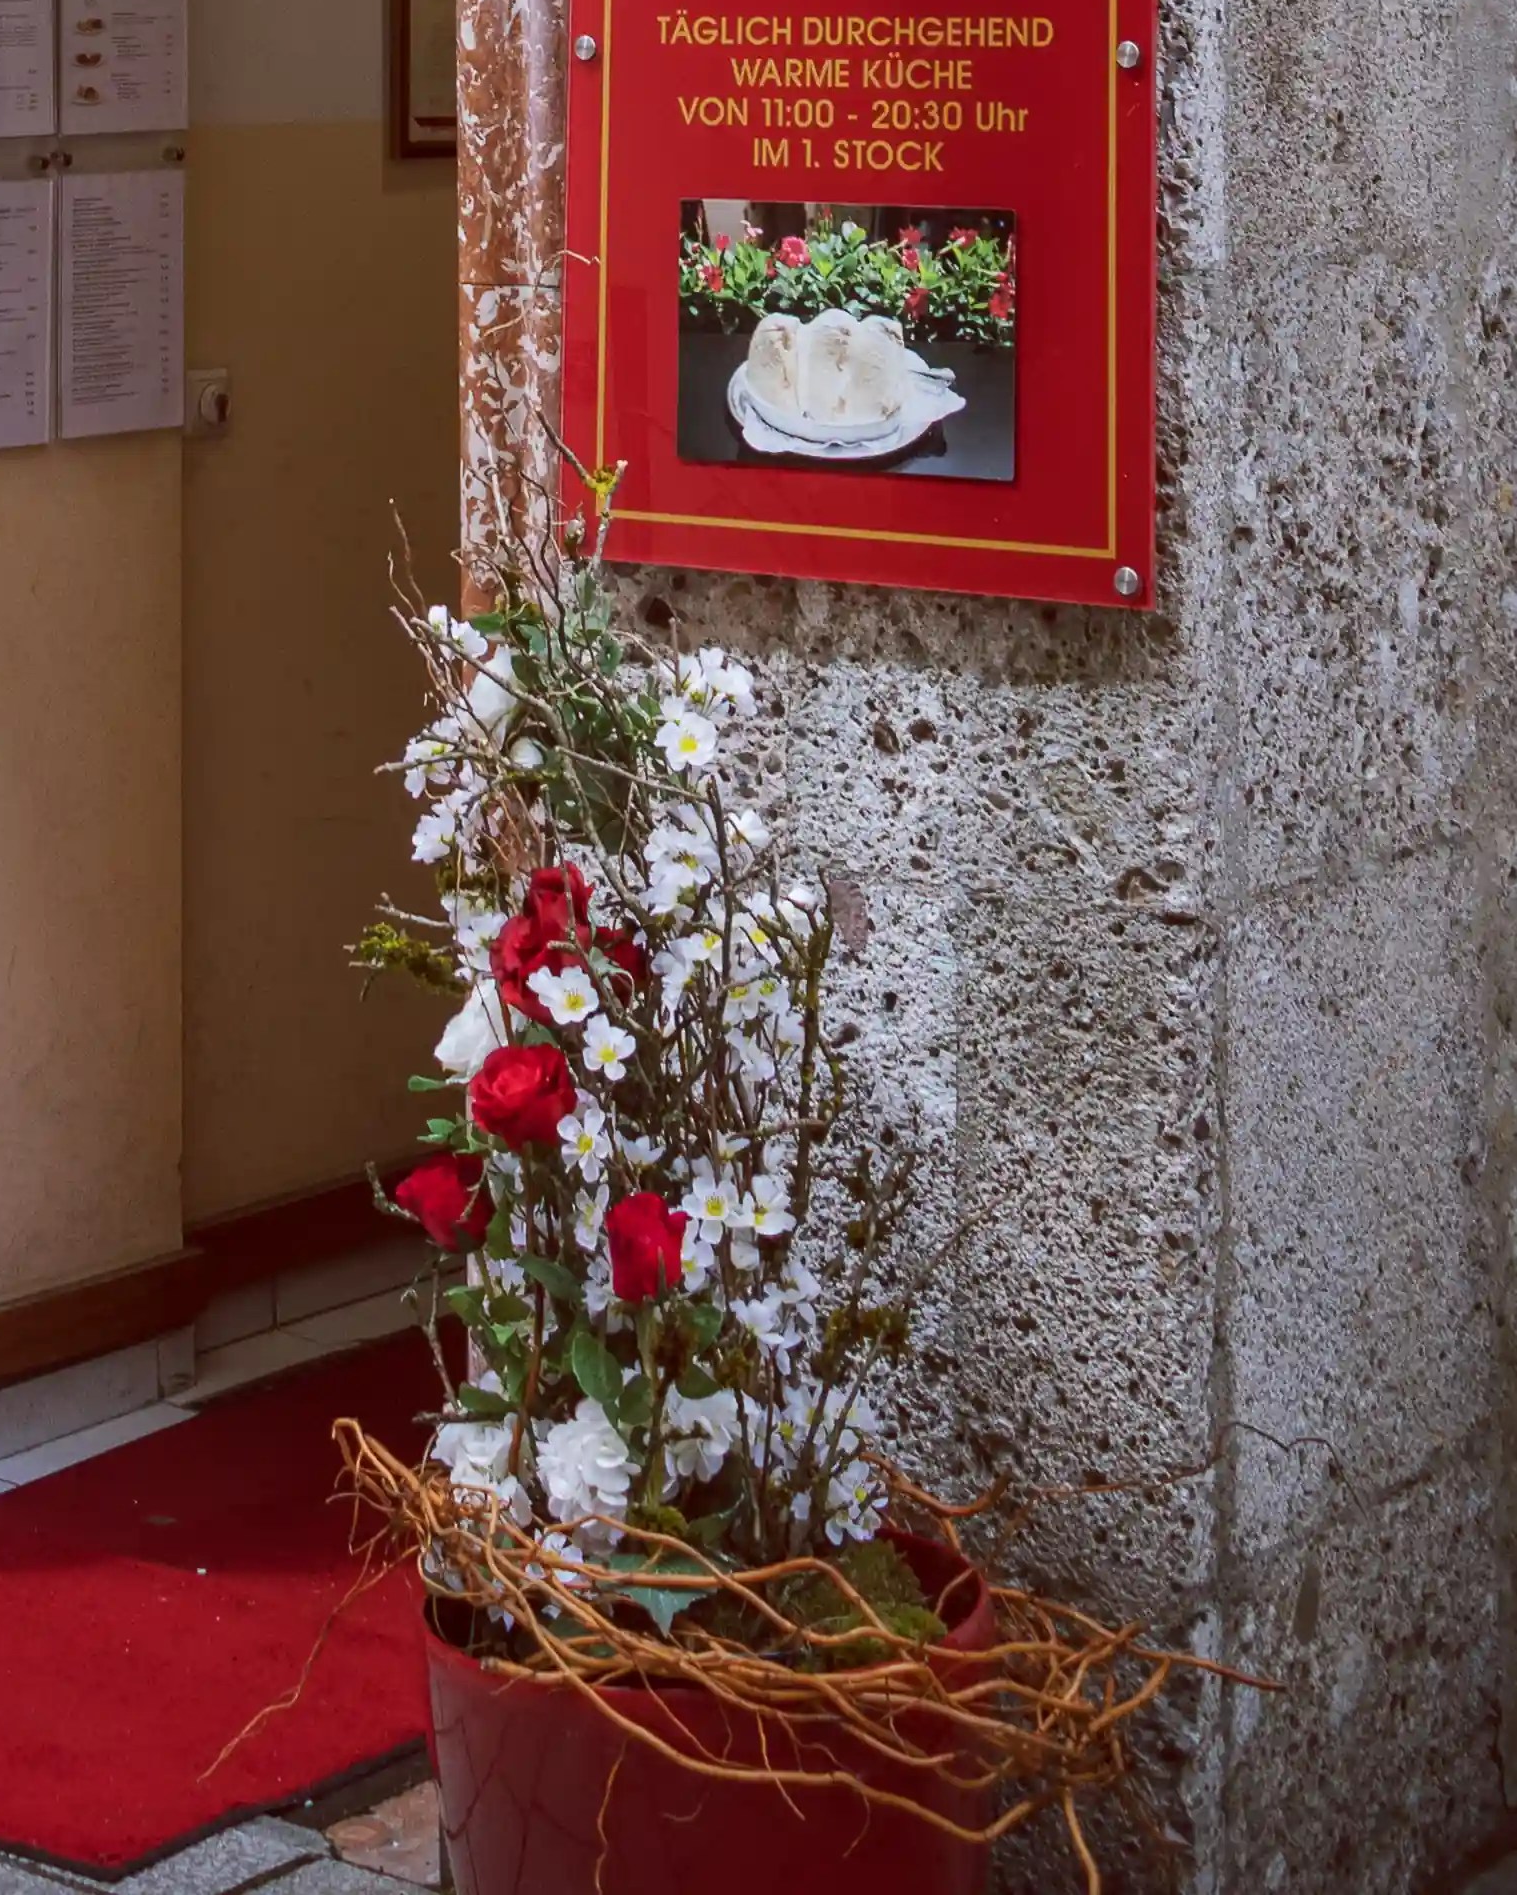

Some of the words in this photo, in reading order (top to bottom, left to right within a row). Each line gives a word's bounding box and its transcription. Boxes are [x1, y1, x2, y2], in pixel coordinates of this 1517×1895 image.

[656, 9, 792, 47] TÄGLICH
[802, 15, 1054, 48] DURCHGEHEND
[730, 58, 850, 89] WARME
[862, 52, 973, 91] KÜCHE
[678, 96, 749, 127] VON
[762, 98, 834, 129] 11:00
[870, 99, 963, 132] 20:30
[975, 102, 1029, 133] Uhr
[752, 138, 789, 168] IM
[801, 139, 820, 169] 1.
[832, 139, 945, 172] STOCK
